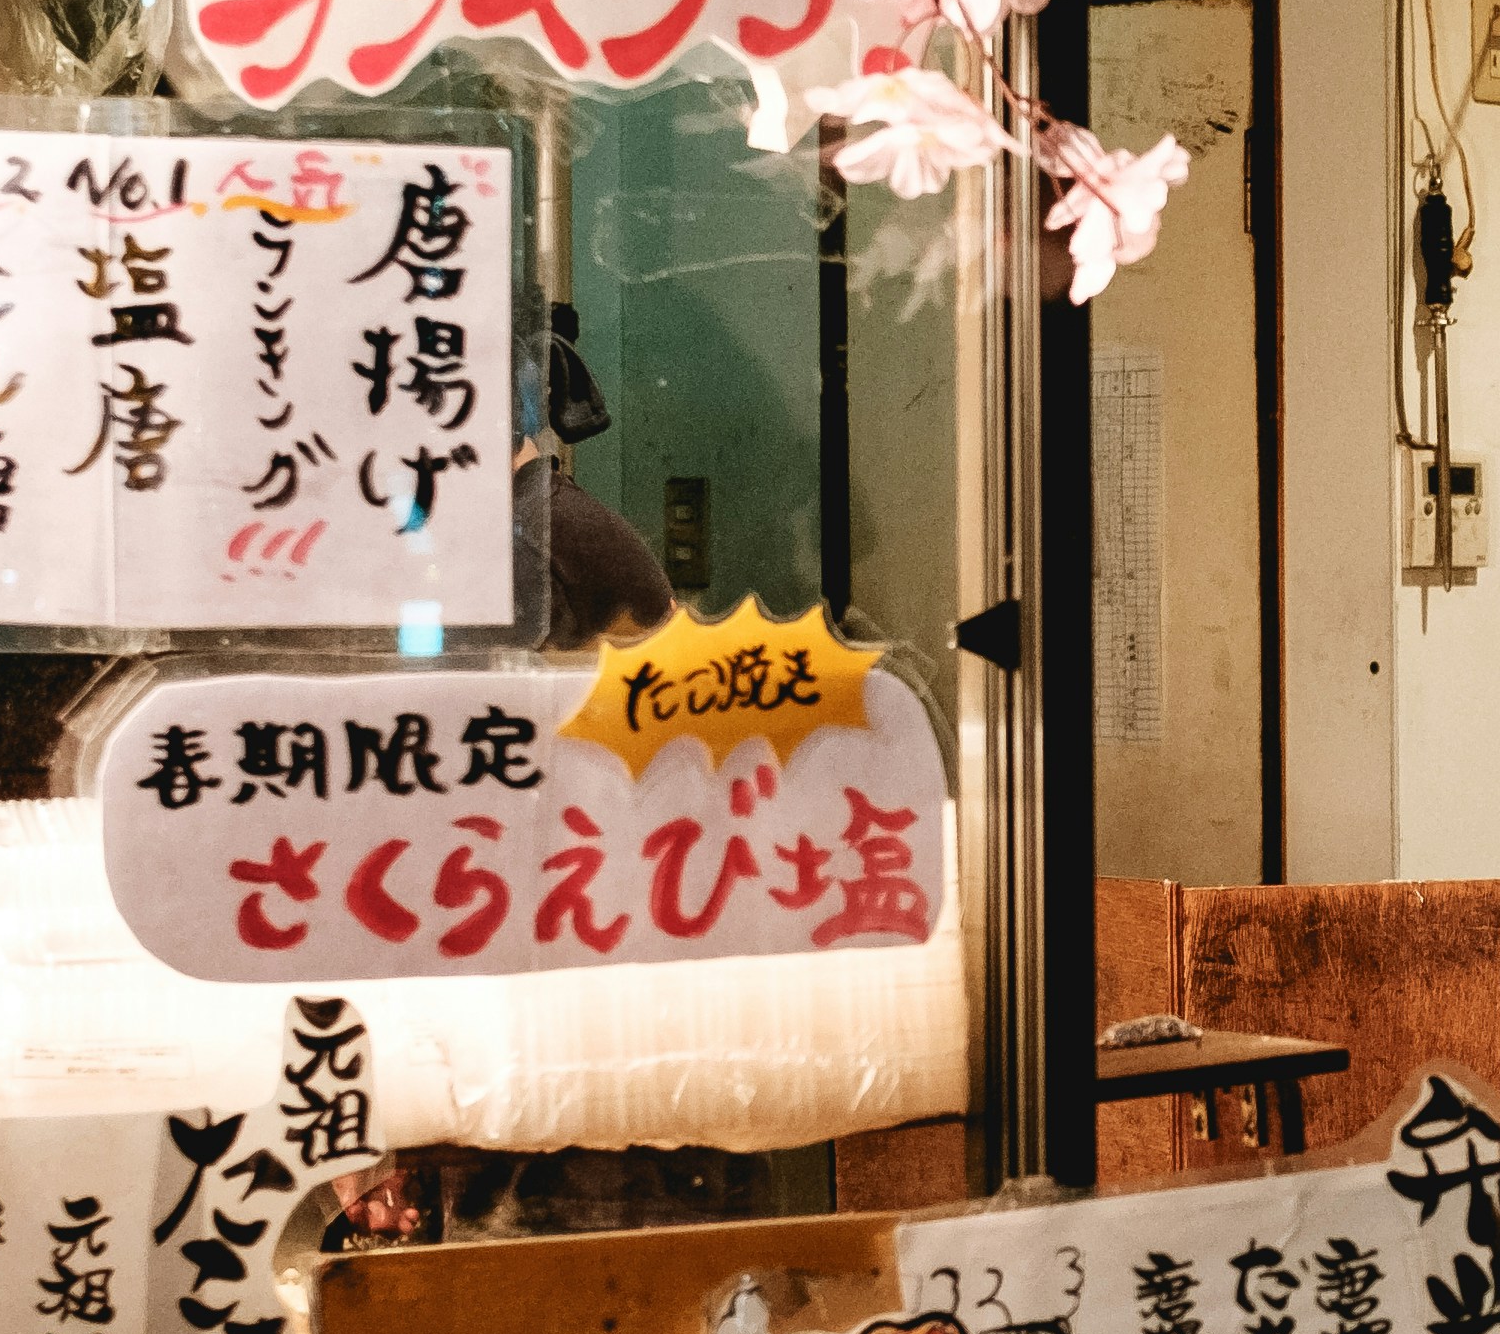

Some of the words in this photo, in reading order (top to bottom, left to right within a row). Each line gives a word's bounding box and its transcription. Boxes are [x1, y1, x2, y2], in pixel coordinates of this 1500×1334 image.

[65, 155, 190, 209] No.1
[65, 236, 195, 490] 塩唐
[350, 165, 480, 535] 唐揚げ
[136, 707, 544, 807] 春期限定
[622, 649, 820, 732] たこ焼き
[229, 766, 929, 957] さくらえび塩
[280, 997, 385, 1166] 元祖
